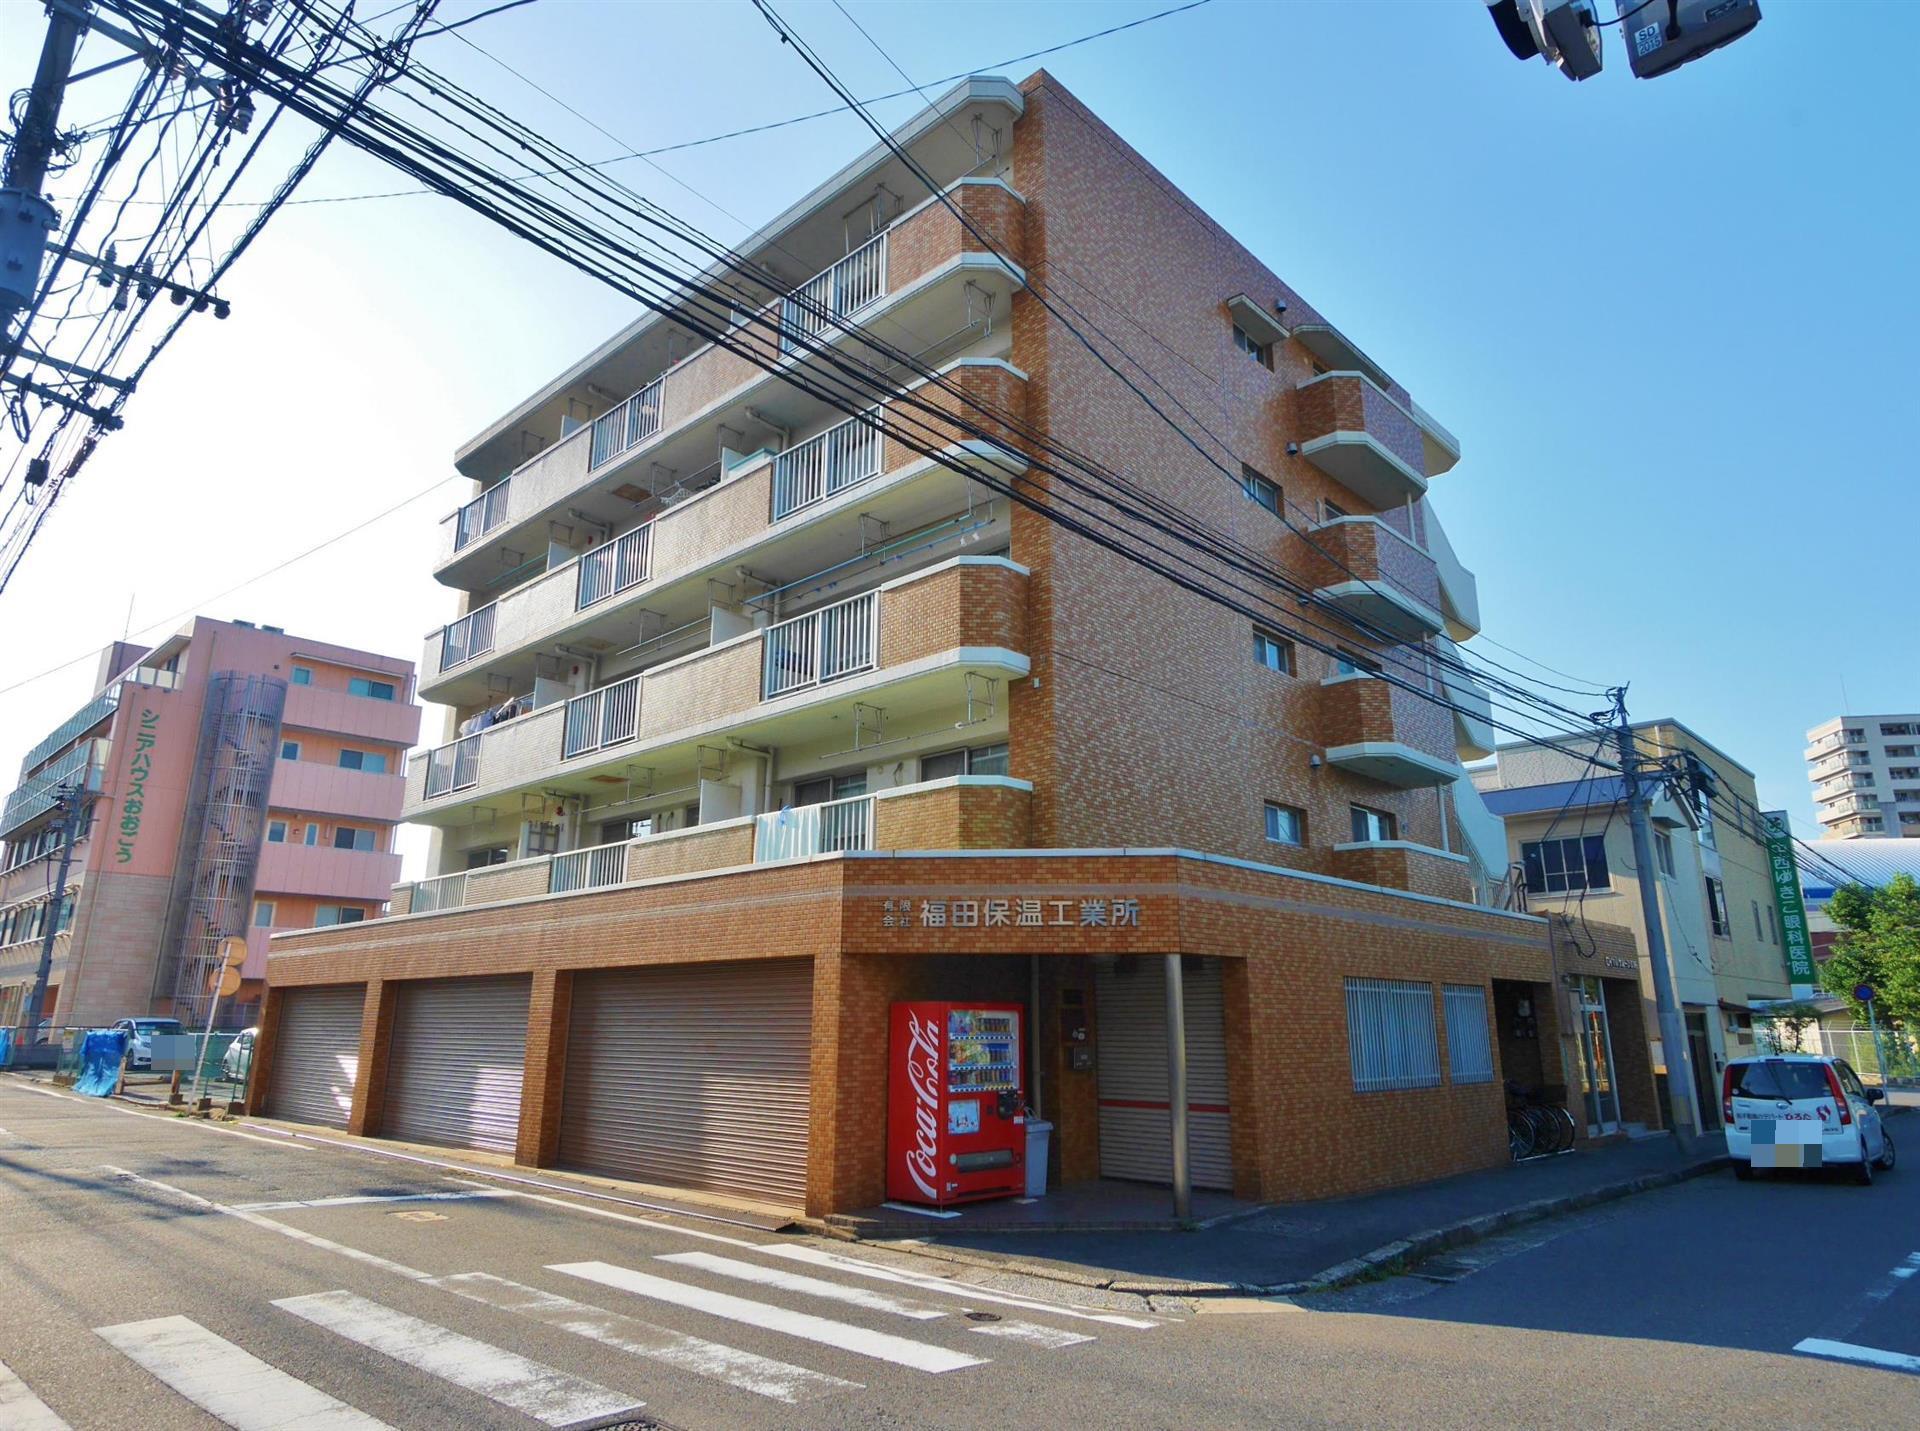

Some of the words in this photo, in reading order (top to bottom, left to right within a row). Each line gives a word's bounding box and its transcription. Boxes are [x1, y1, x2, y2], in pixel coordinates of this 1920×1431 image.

[1638, 26, 1656, 41] SD
[919, 898, 1140, 928] 福田保温工業所
[905, 1008, 939, 1200] Coca-Cola
